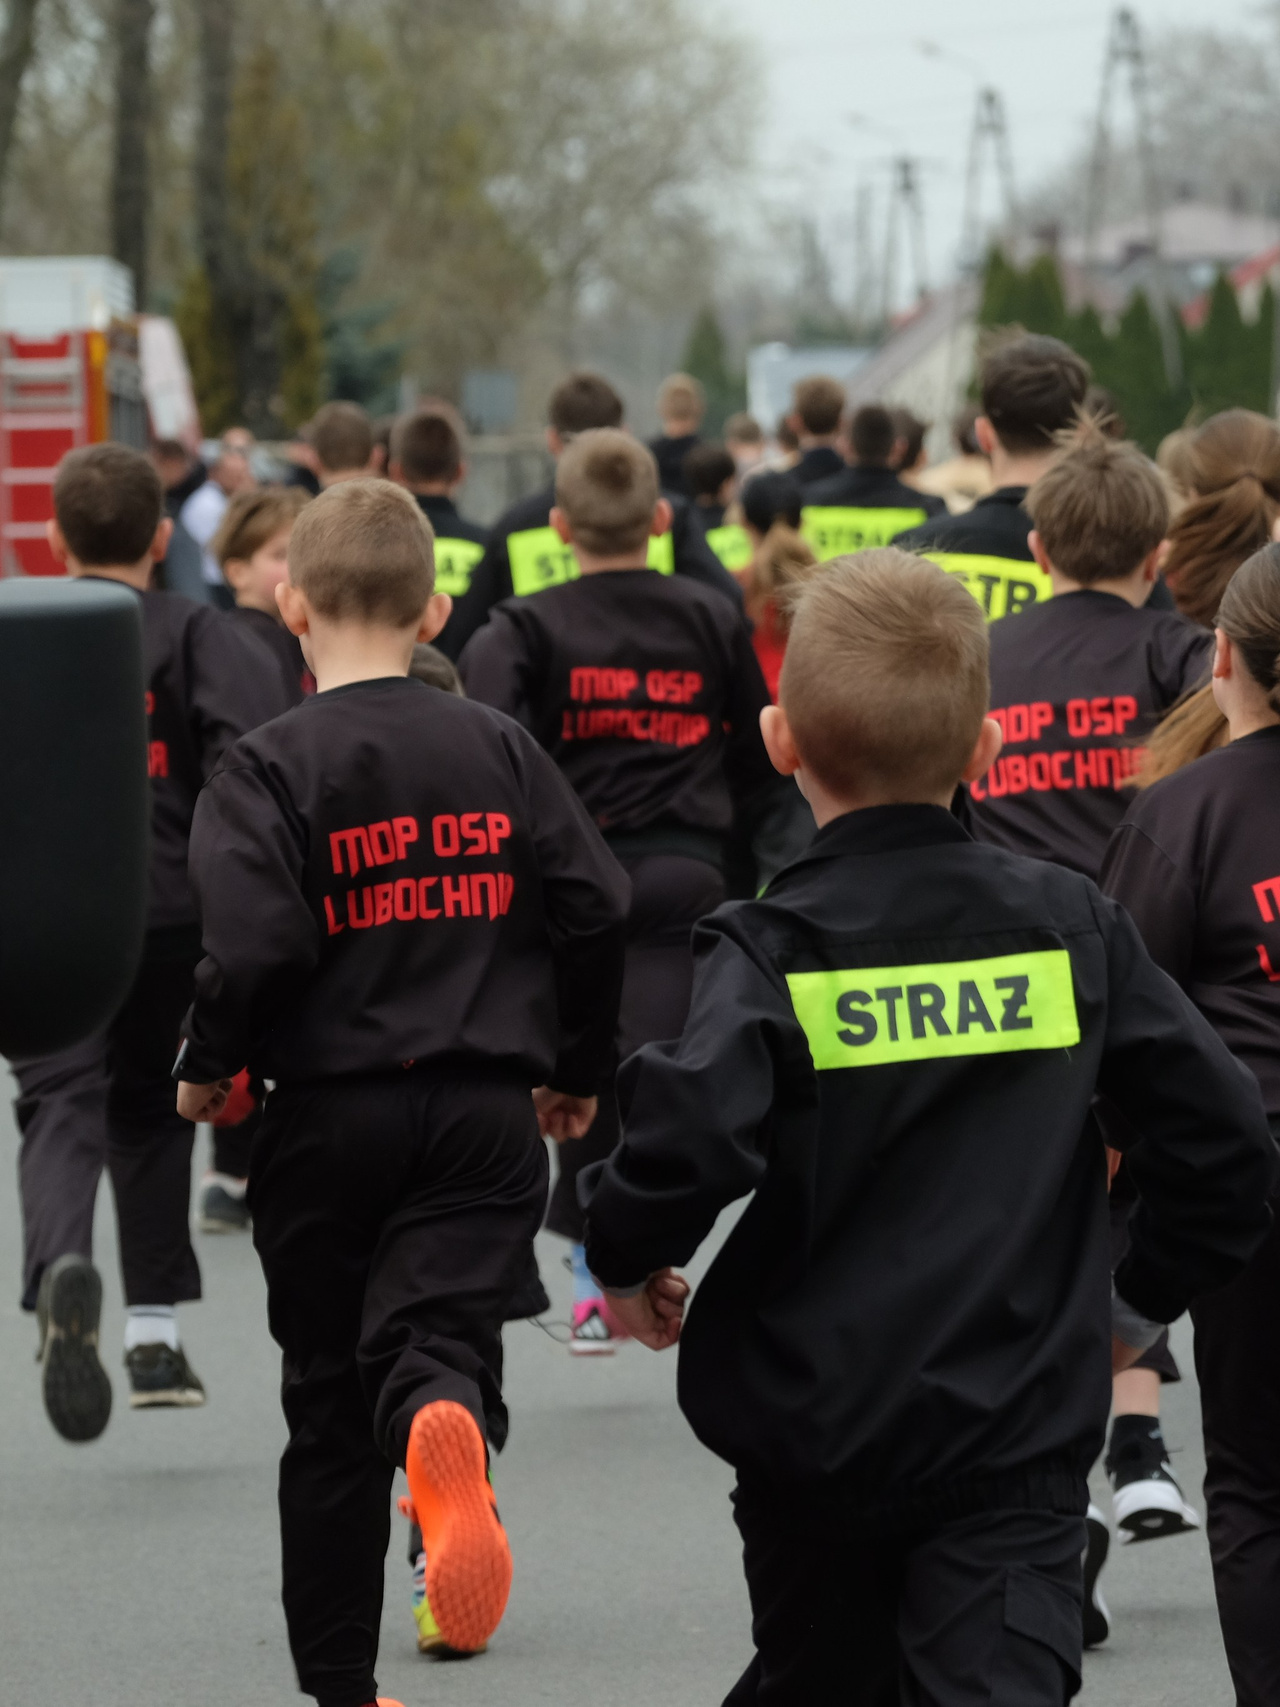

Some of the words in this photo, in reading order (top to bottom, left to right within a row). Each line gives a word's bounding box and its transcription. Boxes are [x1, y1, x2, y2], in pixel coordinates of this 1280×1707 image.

[569, 666, 640, 703] MDP
[645, 669, 703, 704] OSP
[1065, 694, 1139, 739] OSP
[328, 815, 420, 879] MDP
[431, 811, 513, 858] OSP
